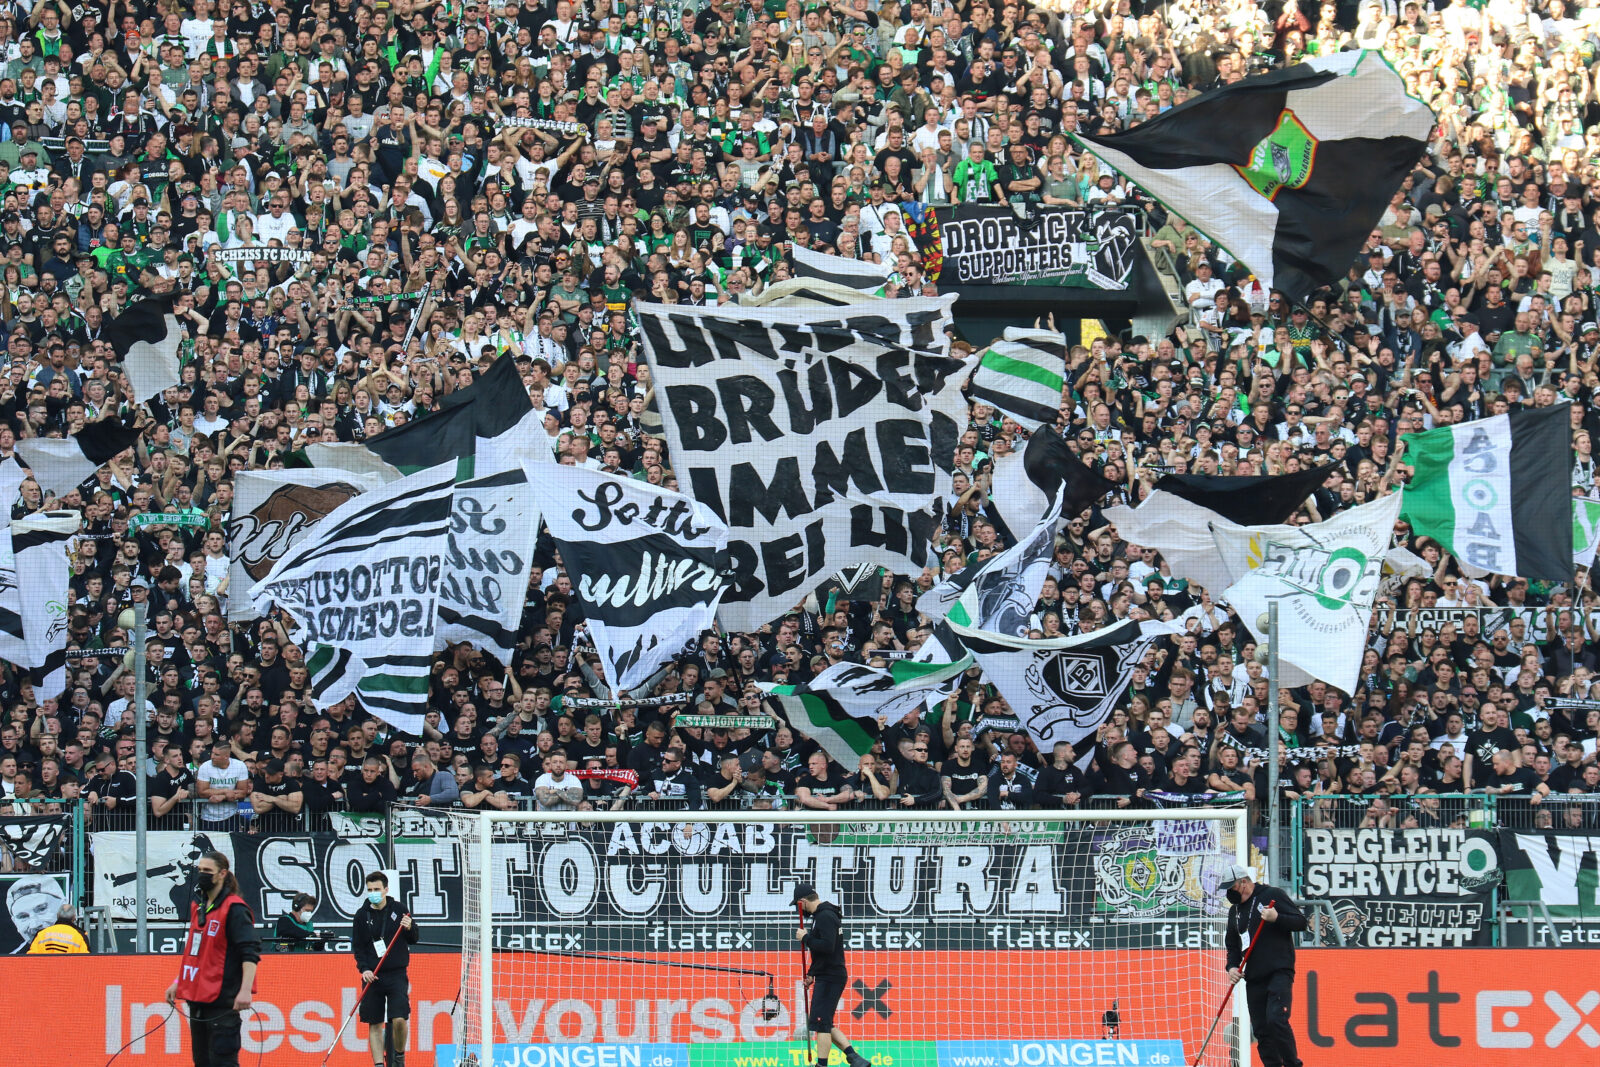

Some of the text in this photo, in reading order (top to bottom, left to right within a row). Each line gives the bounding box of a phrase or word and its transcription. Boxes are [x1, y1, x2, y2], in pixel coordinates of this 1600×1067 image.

[215, 247, 312, 262] SCHEISS FC KÖLN
[958, 243, 1073, 281] SUPPORTERS
[1307, 829, 1465, 864] BEGLEIT
[1307, 862, 1459, 896] SERVICE
[112, 896, 157, 906] rabake
[147, 904, 177, 915] eiber
[1366, 901, 1484, 931] HEUTE
[493, 928, 582, 950] latex
[988, 925, 1091, 948] flatex
[1156, 924, 1221, 948] flat
[1367, 927, 1473, 947] GEHT
[183, 965, 199, 981] TV
[105, 985, 369, 1055] Inest
[493, 980, 844, 1043] yoursel
[1307, 970, 1600, 1049] latex
[504, 1045, 641, 1067] JONGEN
[1004, 1043, 1139, 1067] JONGEN
